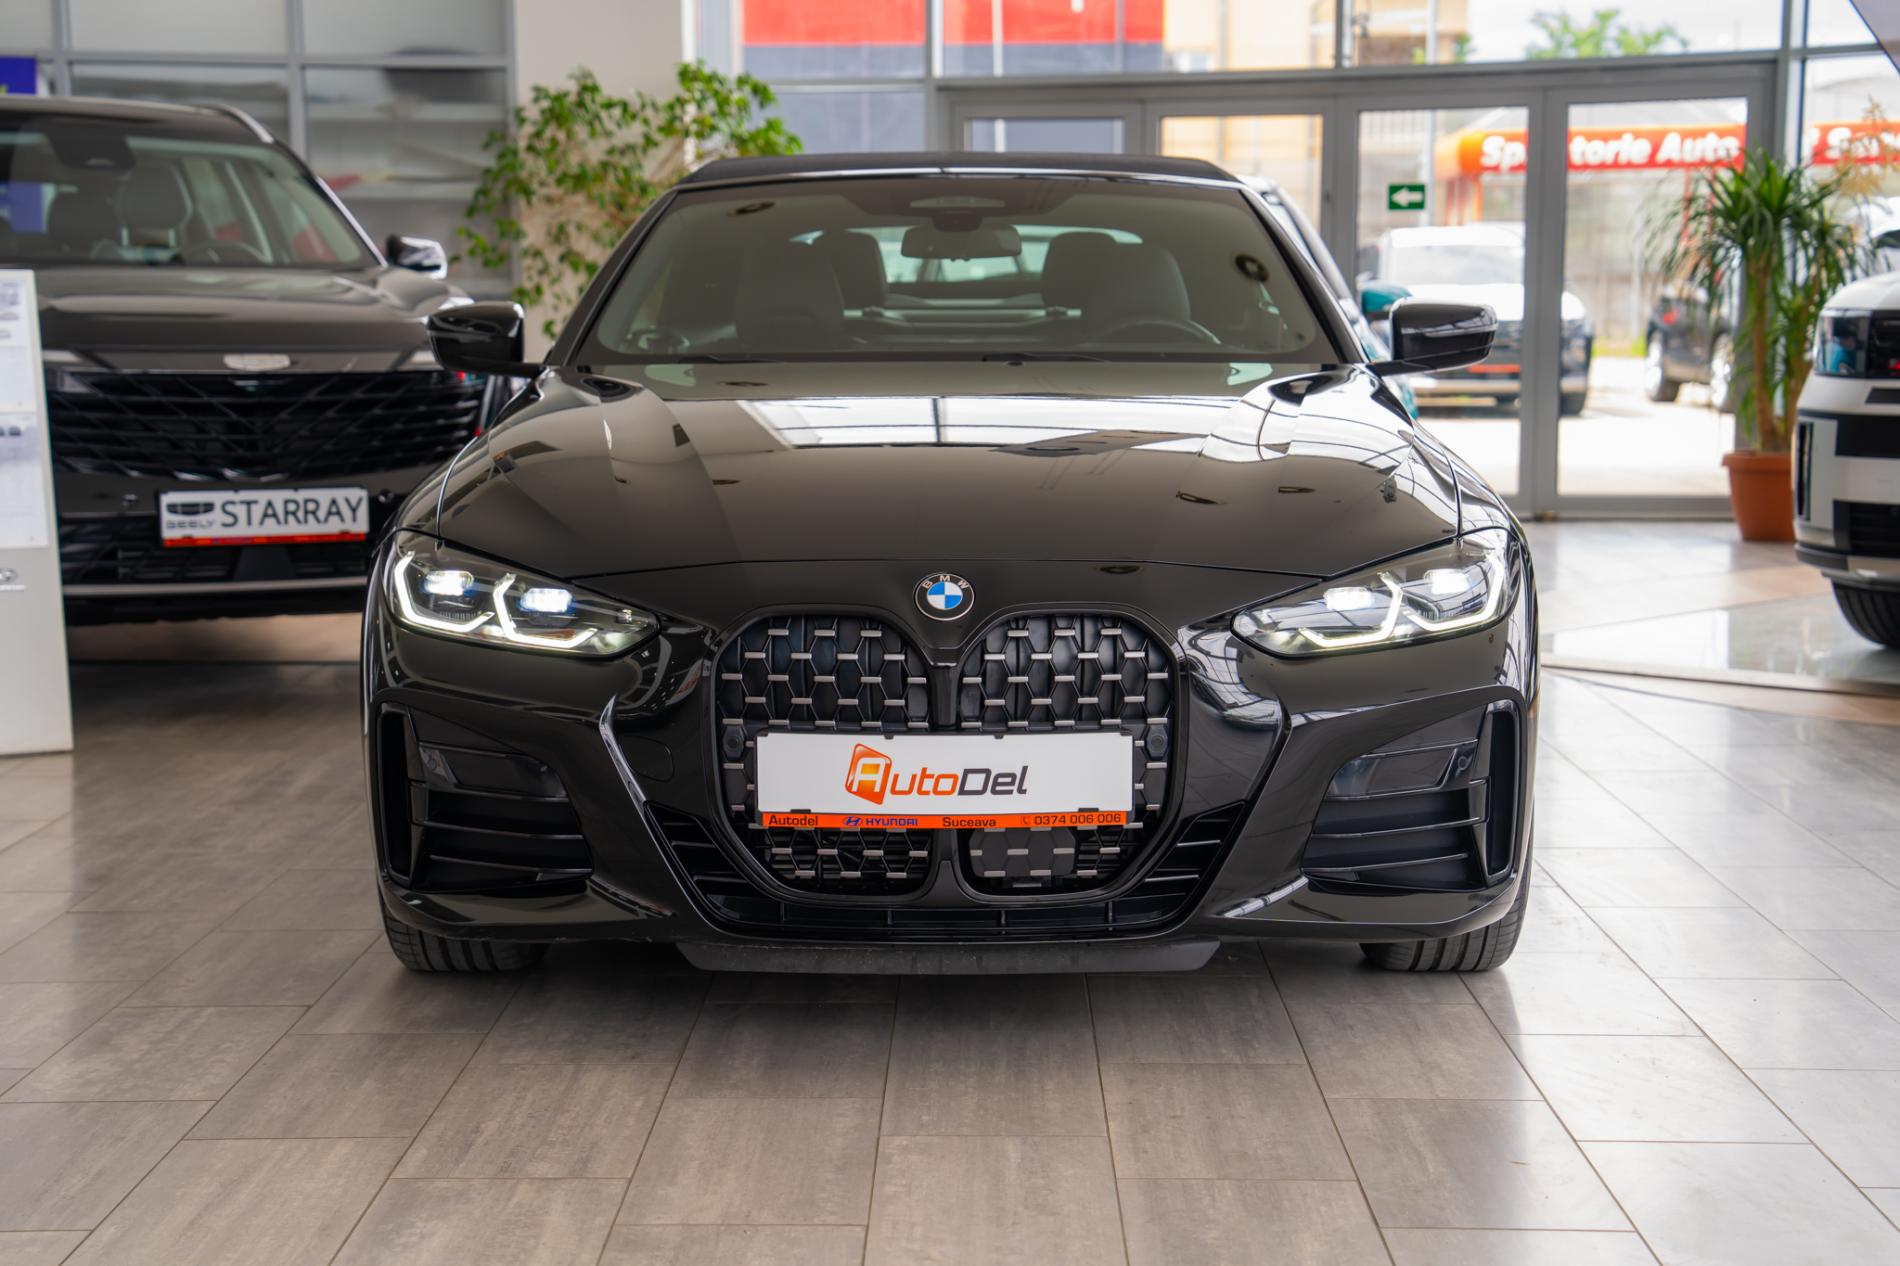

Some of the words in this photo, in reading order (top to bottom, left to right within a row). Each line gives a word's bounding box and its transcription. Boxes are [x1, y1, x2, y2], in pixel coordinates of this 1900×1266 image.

[1655, 132, 1740, 163] Auto
[166, 519, 215, 529] GEELY
[221, 497, 364, 528] STARRAY
[921, 575, 970, 589] BMW
[849, 754, 1029, 798] AutoDel
[768, 814, 818, 826] Autodel
[865, 817, 918, 827] HYUNDAI
[942, 816, 997, 828] Suceava
[1034, 815, 1067, 826] 0374
[1069, 814, 1094, 825] 006
[1097, 813, 1122, 824] 006
